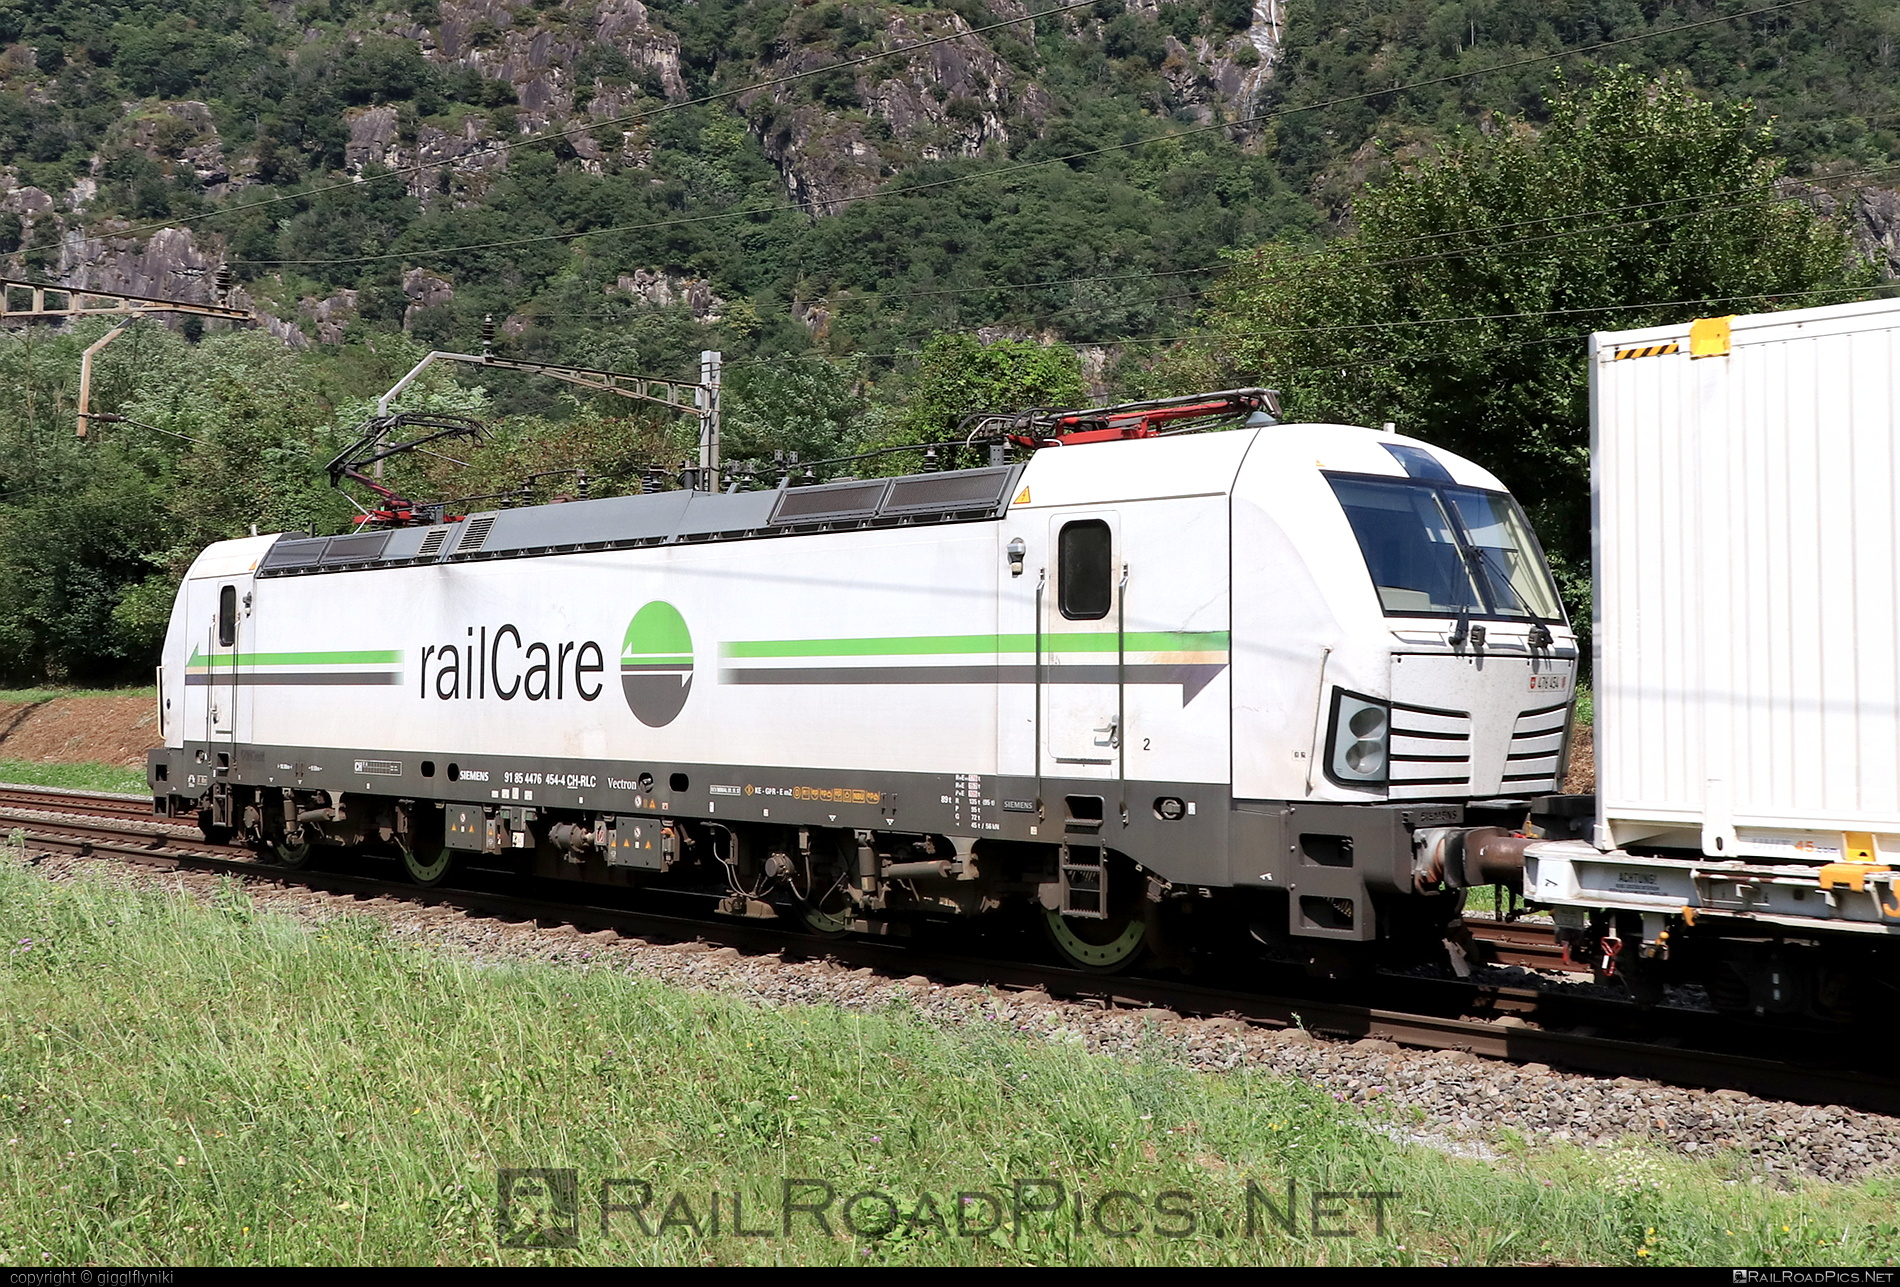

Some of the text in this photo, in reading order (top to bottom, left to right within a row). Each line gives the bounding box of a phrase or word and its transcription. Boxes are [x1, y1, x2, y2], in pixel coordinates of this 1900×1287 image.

[420, 623, 604, 701] railCare
[1143, 737, 1151, 751] 2
[459, 770, 490, 782] SIEMENS
[504, 772, 597, 789] 91 85 4476 454-4 CH-RLC
[607, 777, 637, 791] Vectron
[1003, 800, 1033, 810] SIEMENS
[1420, 810, 1458, 822] SIEMENS
